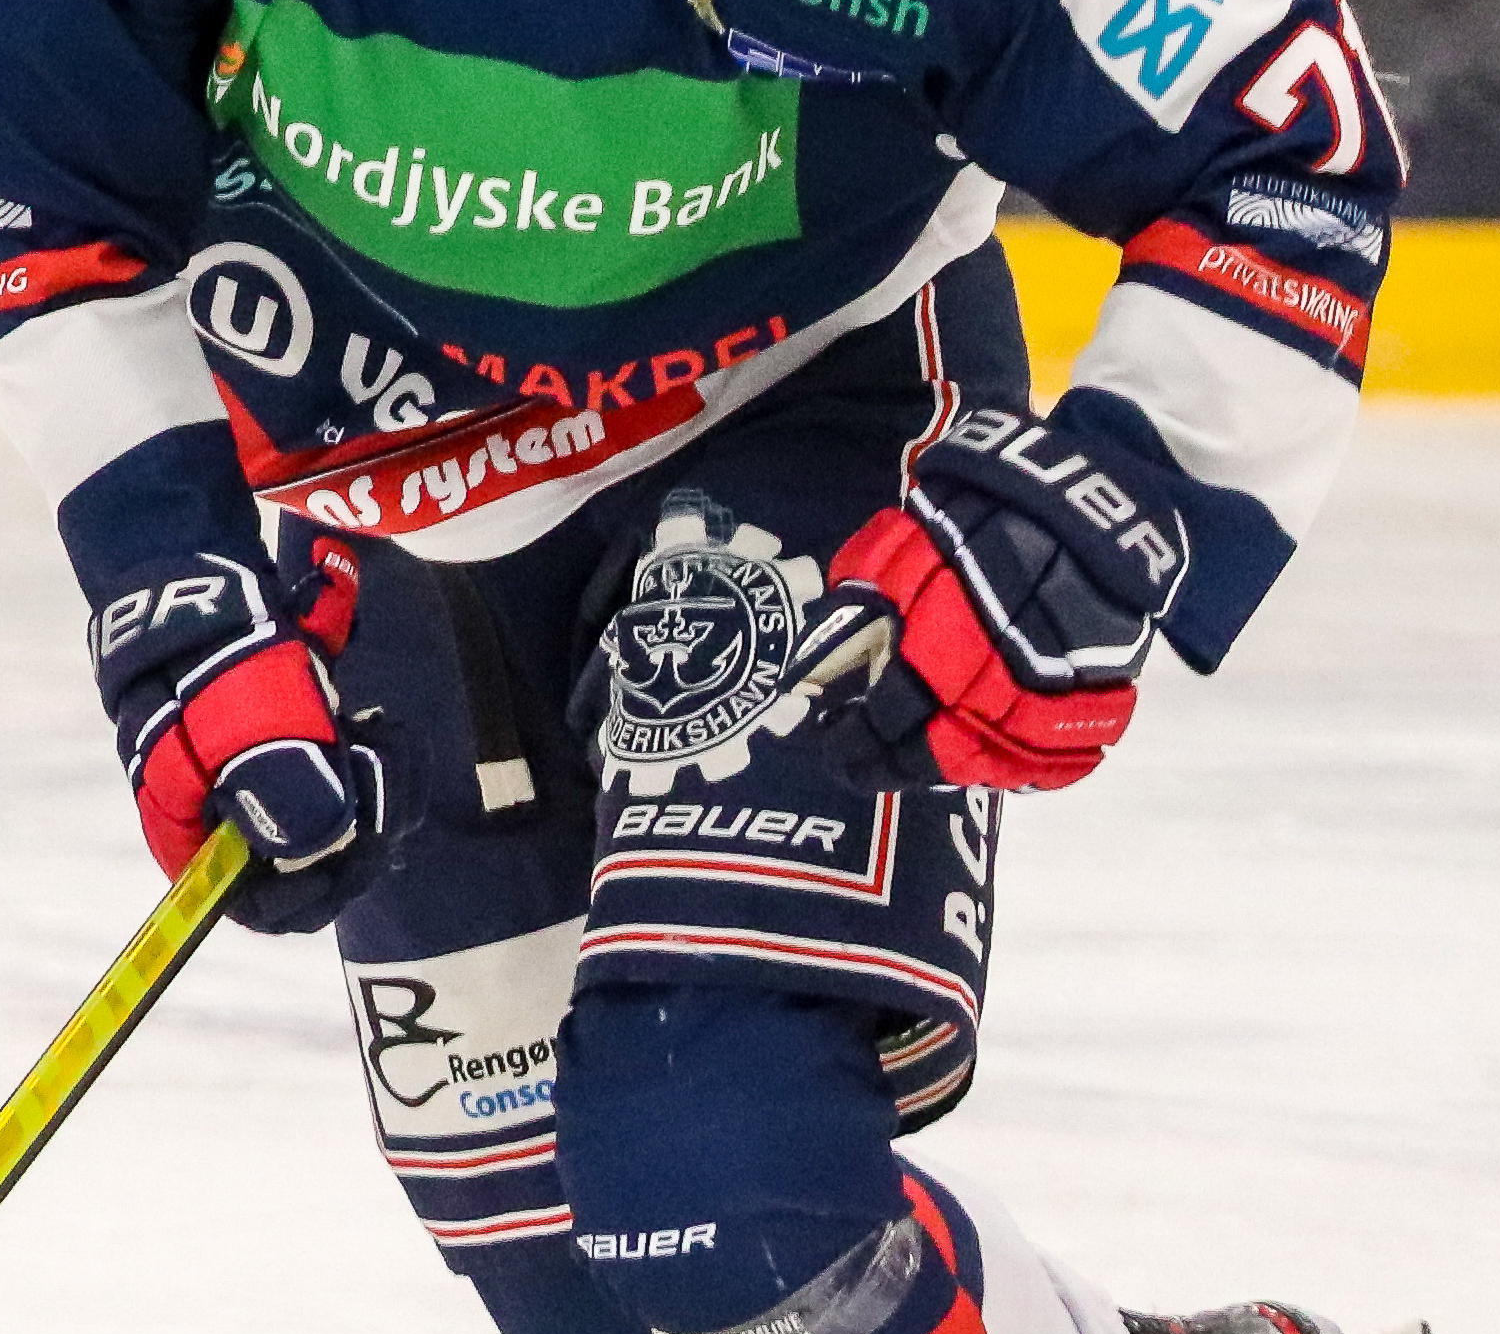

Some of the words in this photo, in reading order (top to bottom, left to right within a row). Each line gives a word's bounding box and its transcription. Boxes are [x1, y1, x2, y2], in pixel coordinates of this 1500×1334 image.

[252, 69, 605, 236] Nordjyske
[627, 126, 785, 238] Bank
[400, 408, 606, 515] system
[947, 408, 1178, 586] AUER
[608, 658, 781, 754] DERIKSHAVN
[611, 804, 847, 854] BAUER
